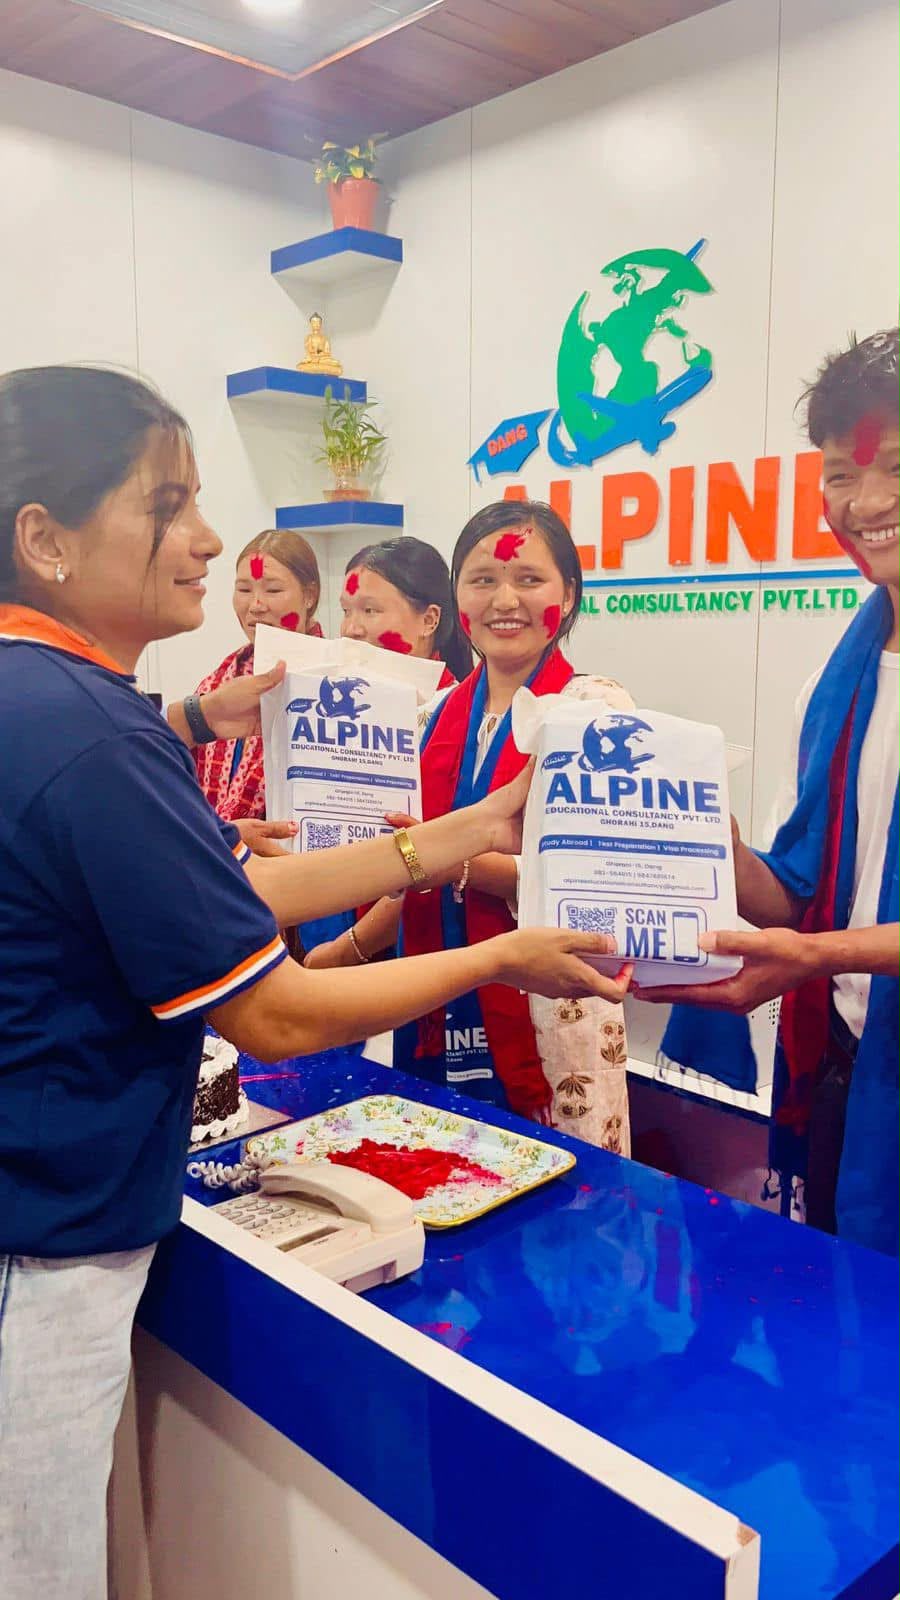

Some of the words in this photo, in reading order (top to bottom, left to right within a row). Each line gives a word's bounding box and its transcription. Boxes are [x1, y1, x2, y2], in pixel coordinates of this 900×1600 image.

[487, 424, 527, 456] DANG
[503, 451, 848, 570] LPINE
[606, 591, 752, 614] CONSULTANCY
[291, 716, 415, 755] ALPINE
[291, 744, 338, 754] EDUCATIONAL
[340, 748, 386, 760] CONSULTANCY
[546, 773, 721, 814] ALPINE
[545, 806, 609, 816] EDUCATIONAL
[612, 809, 680, 821] CONSULTANCY
[600, 818, 638, 827] GHORAHI
[348, 825, 376, 839] SCAN
[561, 839, 588, 847] Abroad
[598, 840, 613, 848] Test
[662, 844, 679, 852] Visa
[680, 846, 719, 857] Processing
[625, 908, 666, 926] SCAN
[625, 927, 667, 960] ME
